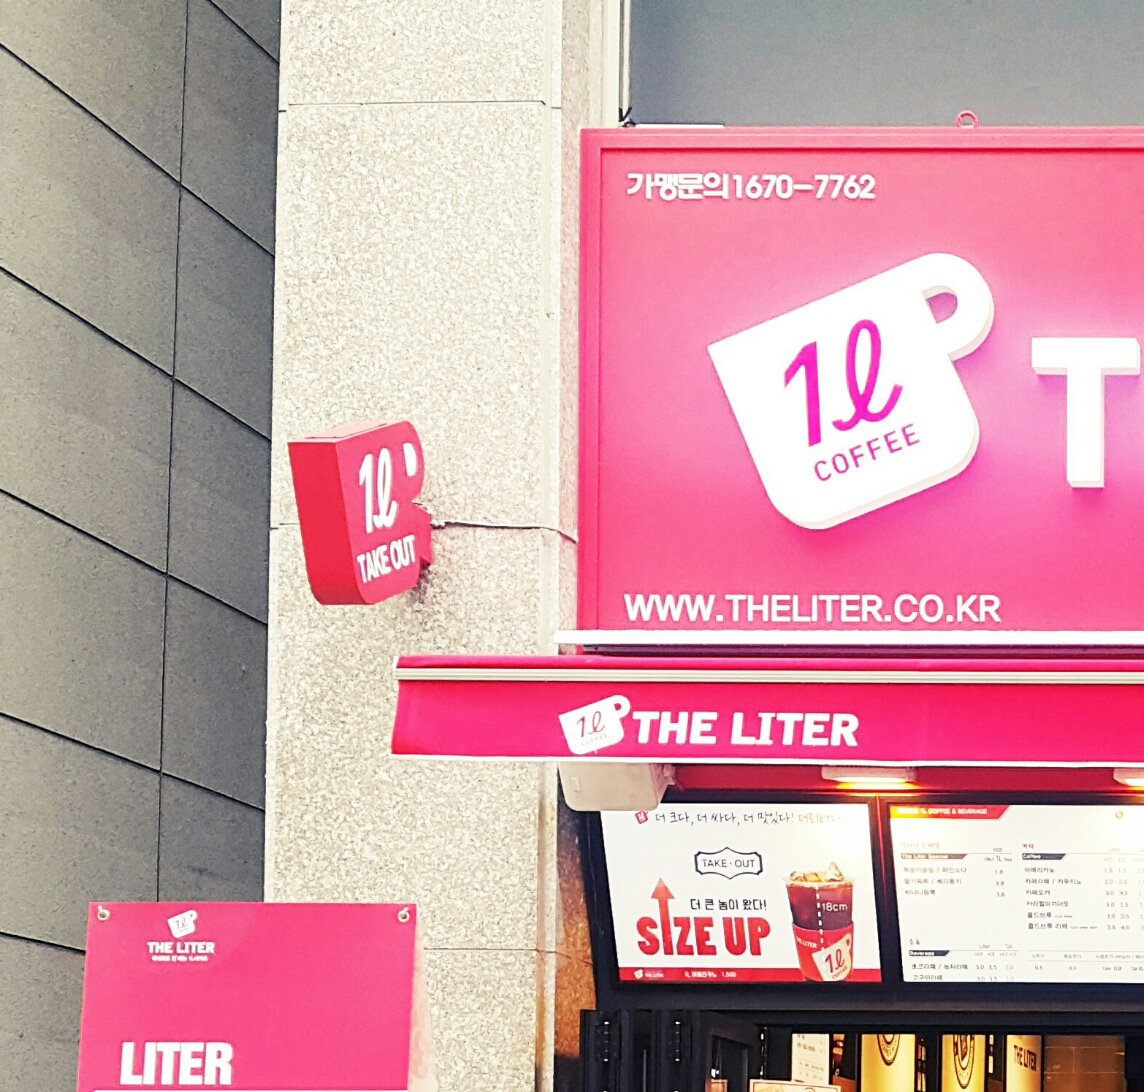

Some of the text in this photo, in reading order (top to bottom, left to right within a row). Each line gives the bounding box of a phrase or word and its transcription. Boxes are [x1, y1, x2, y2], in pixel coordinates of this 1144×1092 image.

[626, 172, 876, 201] 가맹문의 1670-7762
[813, 422, 921, 482] COFFEE
[357, 534, 416, 583] TAKE OUT
[624, 594, 1001, 622] WWW.THELITER.CO.KR
[632, 711, 717, 744] THE
[730, 712, 859, 746] LITER
[655, 813, 666, 823] 더
[697, 813, 707, 823] 더
[744, 813, 754, 823] 더
[702, 858, 755, 868] TAKE OUT
[690, 899, 700, 910] 더
[705, 899, 714, 910] 큰
[822, 902, 848, 911] 18cm
[147, 942, 215, 954] THE LITER
[723, 917, 770, 955] UP
[120, 1041, 234, 1085] LITER
